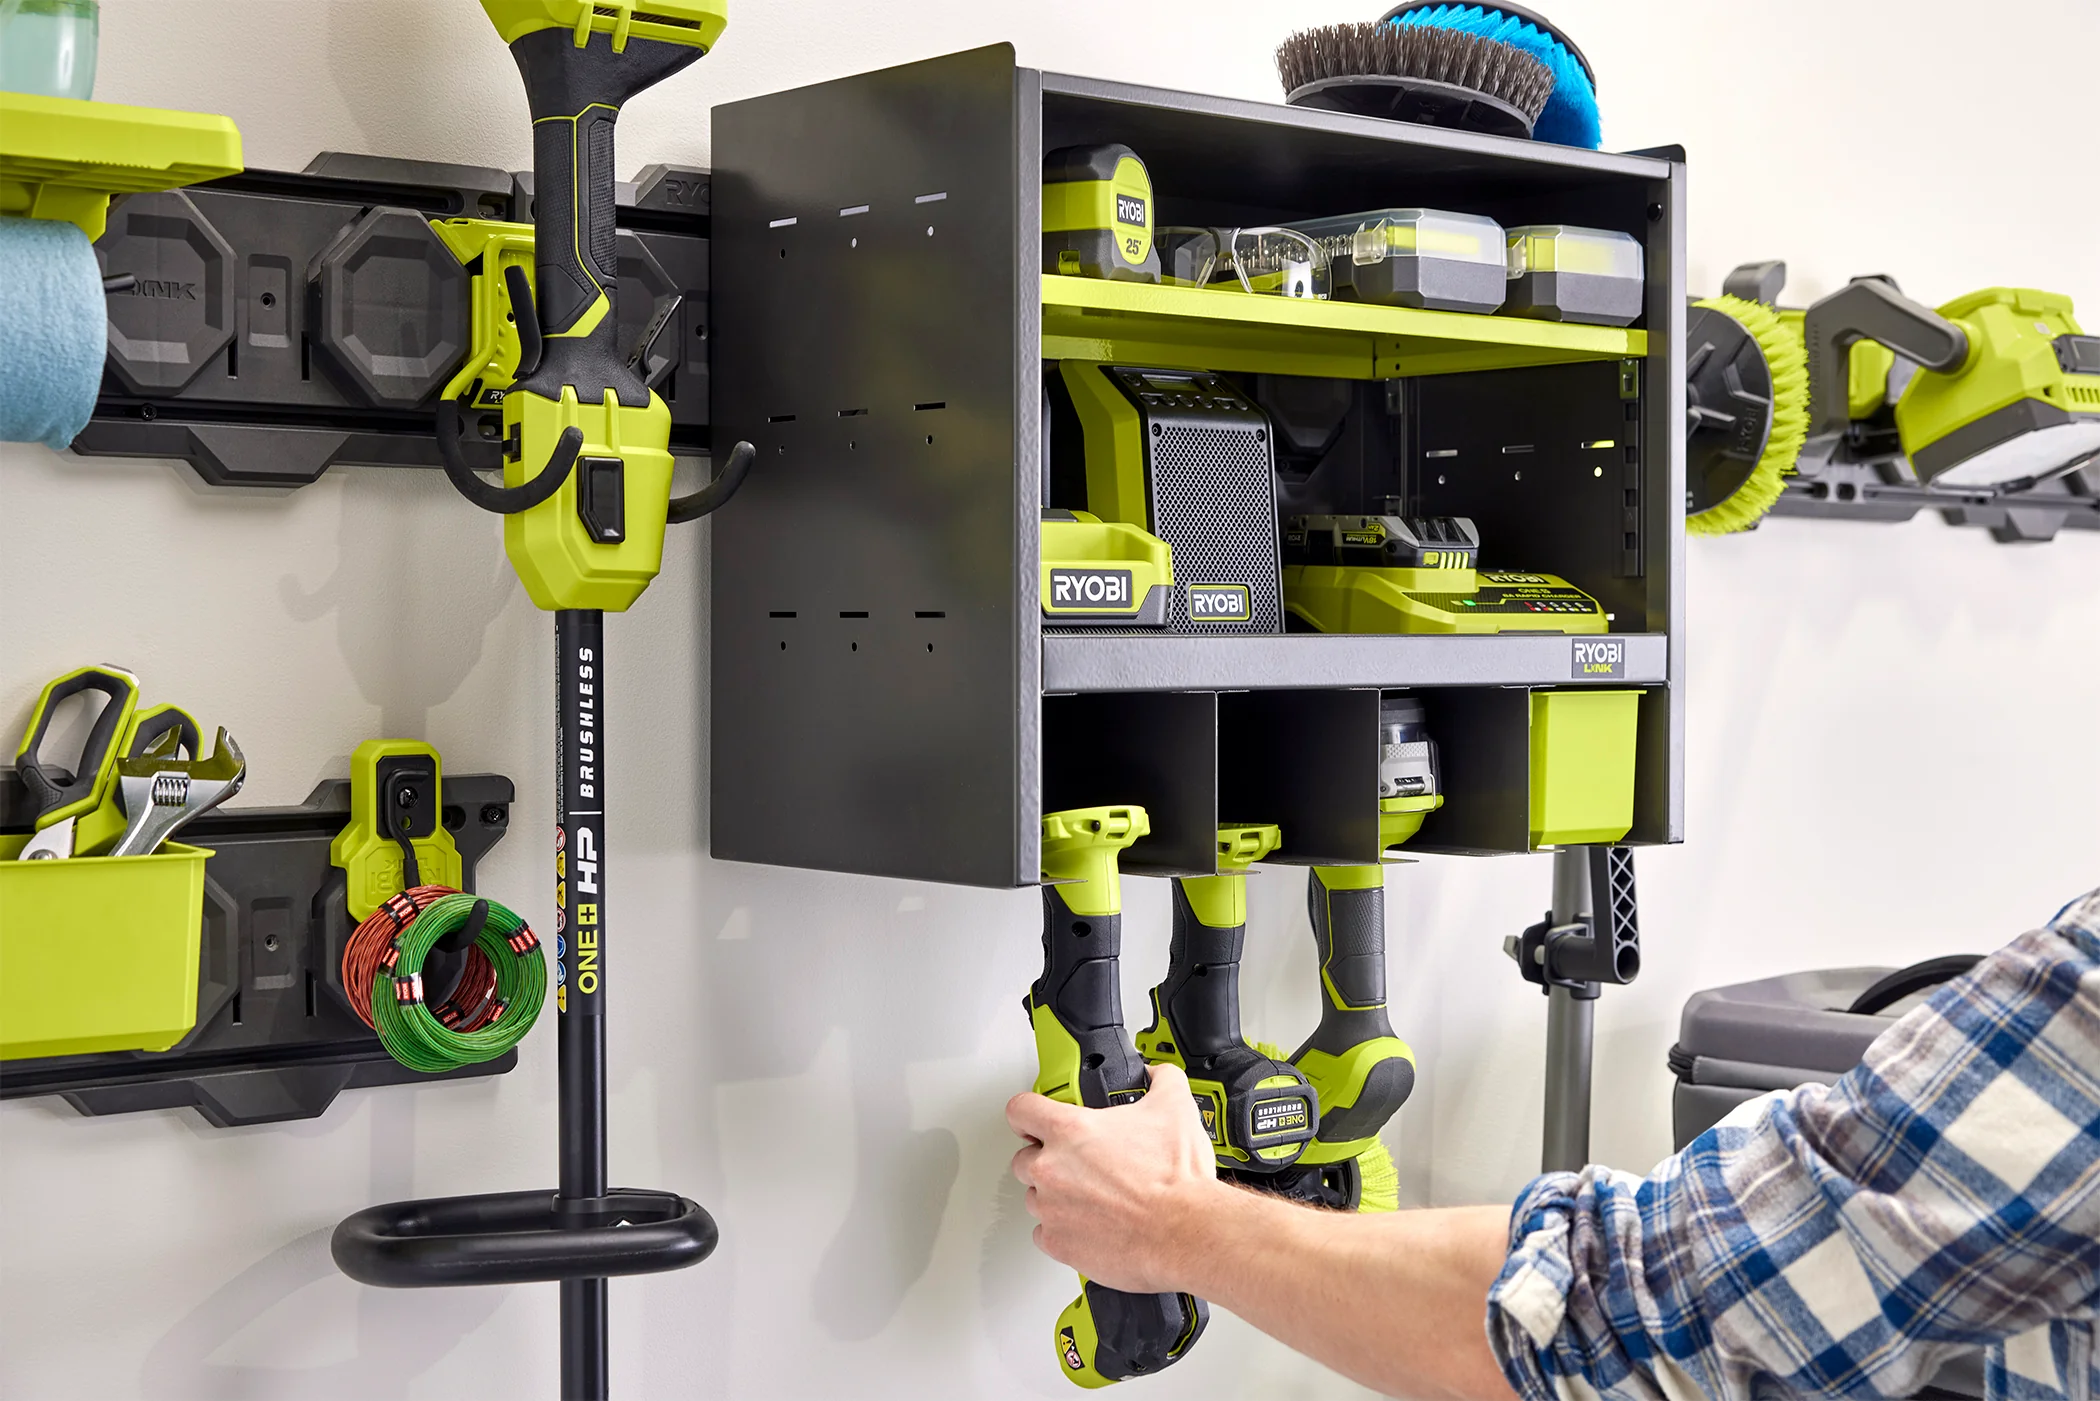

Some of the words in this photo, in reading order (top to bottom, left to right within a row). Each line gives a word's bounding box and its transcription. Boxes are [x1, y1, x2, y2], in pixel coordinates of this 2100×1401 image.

[1118, 199, 1144, 223] RYOBI
[1484, 573, 1545, 583] RYOBI
[1054, 575, 1127, 602] RYOBI
[1193, 593, 1243, 613] RYOBI
[1574, 643, 1622, 663] RYOBI
[1584, 663, 1613, 673] LINK
[579, 647, 594, 798] BRUSHLESS
[577, 826, 597, 894] HP
[1258, 1103, 1302, 1116] BRUSHLESS
[1257, 1118, 1277, 1130] HP
